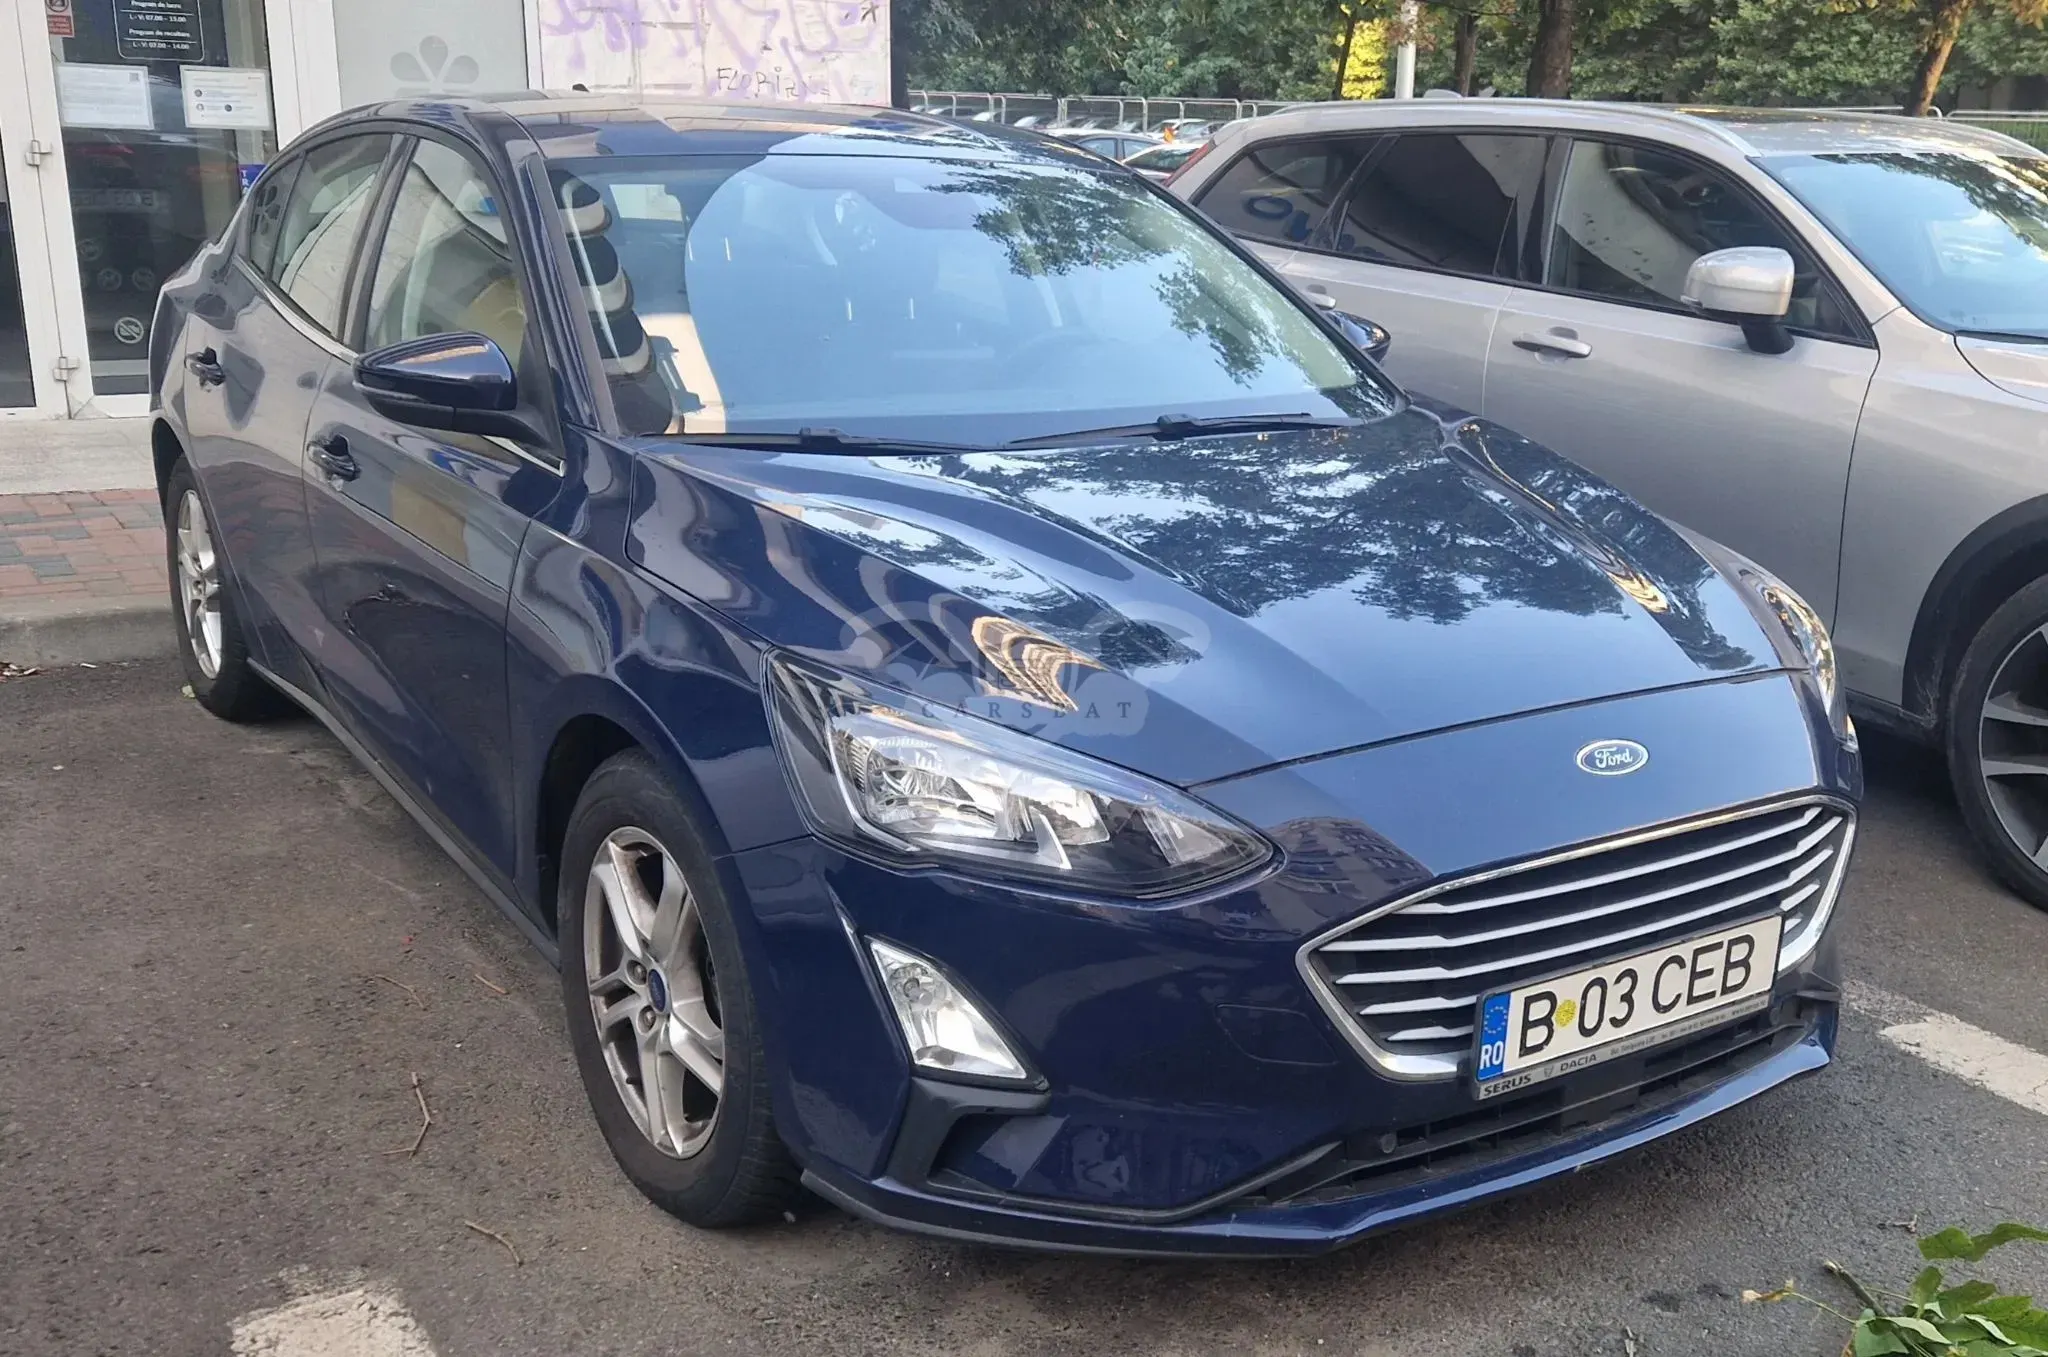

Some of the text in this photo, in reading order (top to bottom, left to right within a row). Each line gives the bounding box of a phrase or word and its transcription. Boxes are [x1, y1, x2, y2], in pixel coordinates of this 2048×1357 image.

[1594, 746, 1634, 769] Ford
[1519, 933, 1756, 1059] B 03 CEB
[1479, 1040, 1504, 1071] RO
[1483, 1053, 1598, 1098] SERUS DACIA
